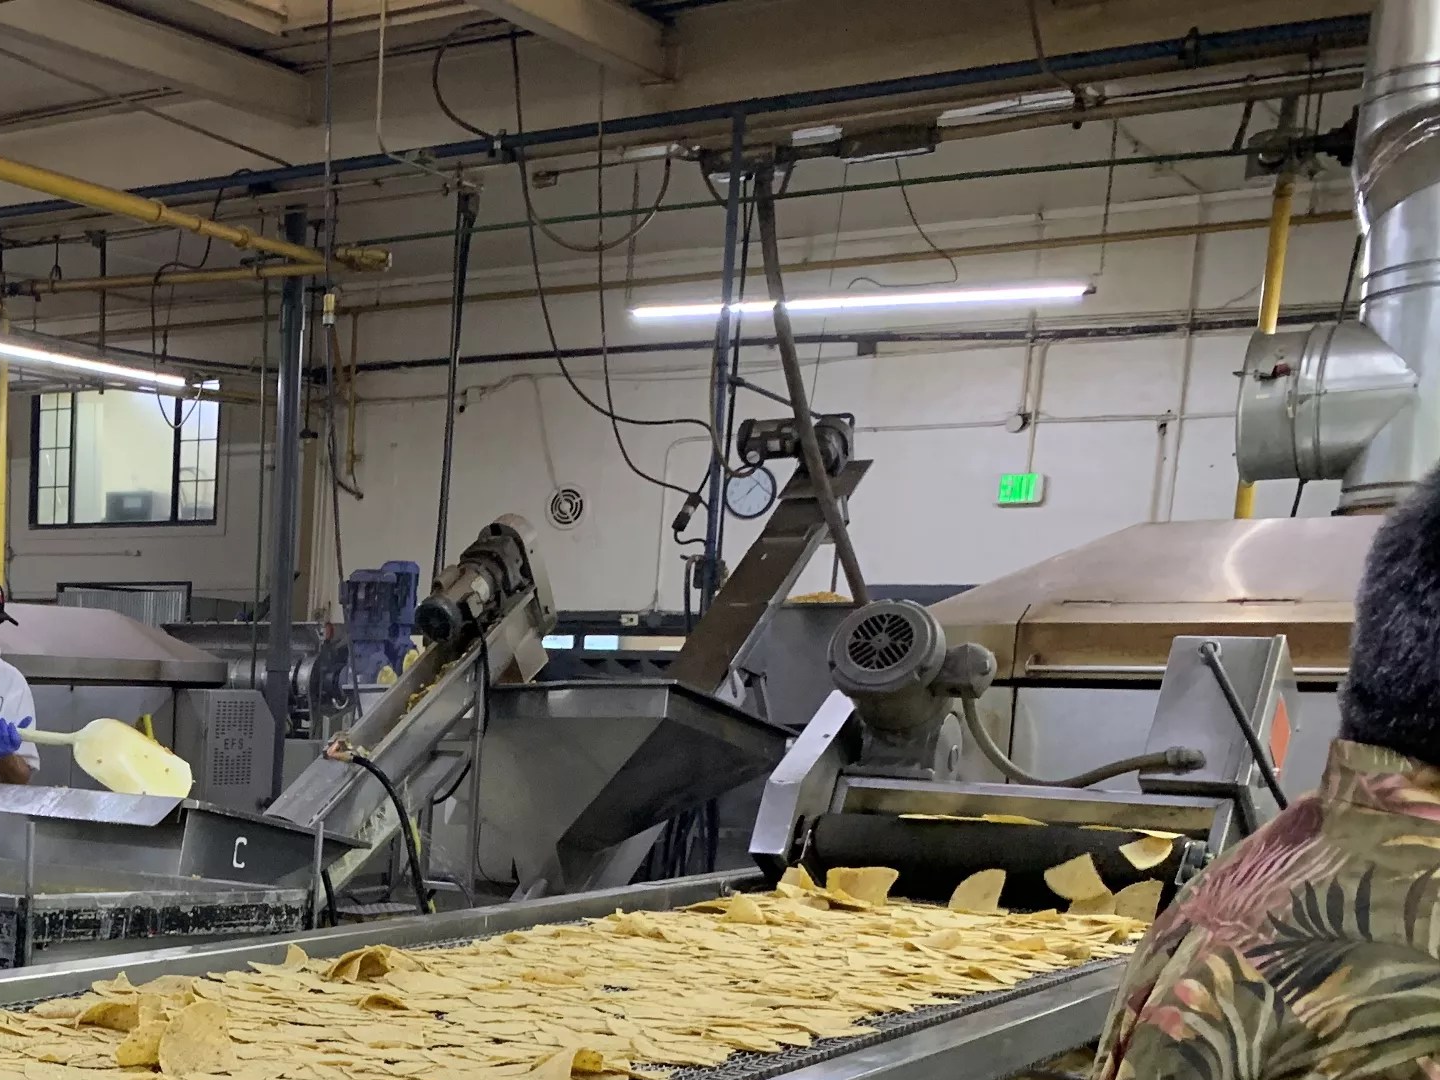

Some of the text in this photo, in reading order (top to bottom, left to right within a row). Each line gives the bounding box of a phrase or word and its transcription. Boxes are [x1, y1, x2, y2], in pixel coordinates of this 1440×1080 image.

[1000, 475, 1037, 501] EXIT
[224, 738, 243, 750] EFS
[232, 836, 248, 869] C
